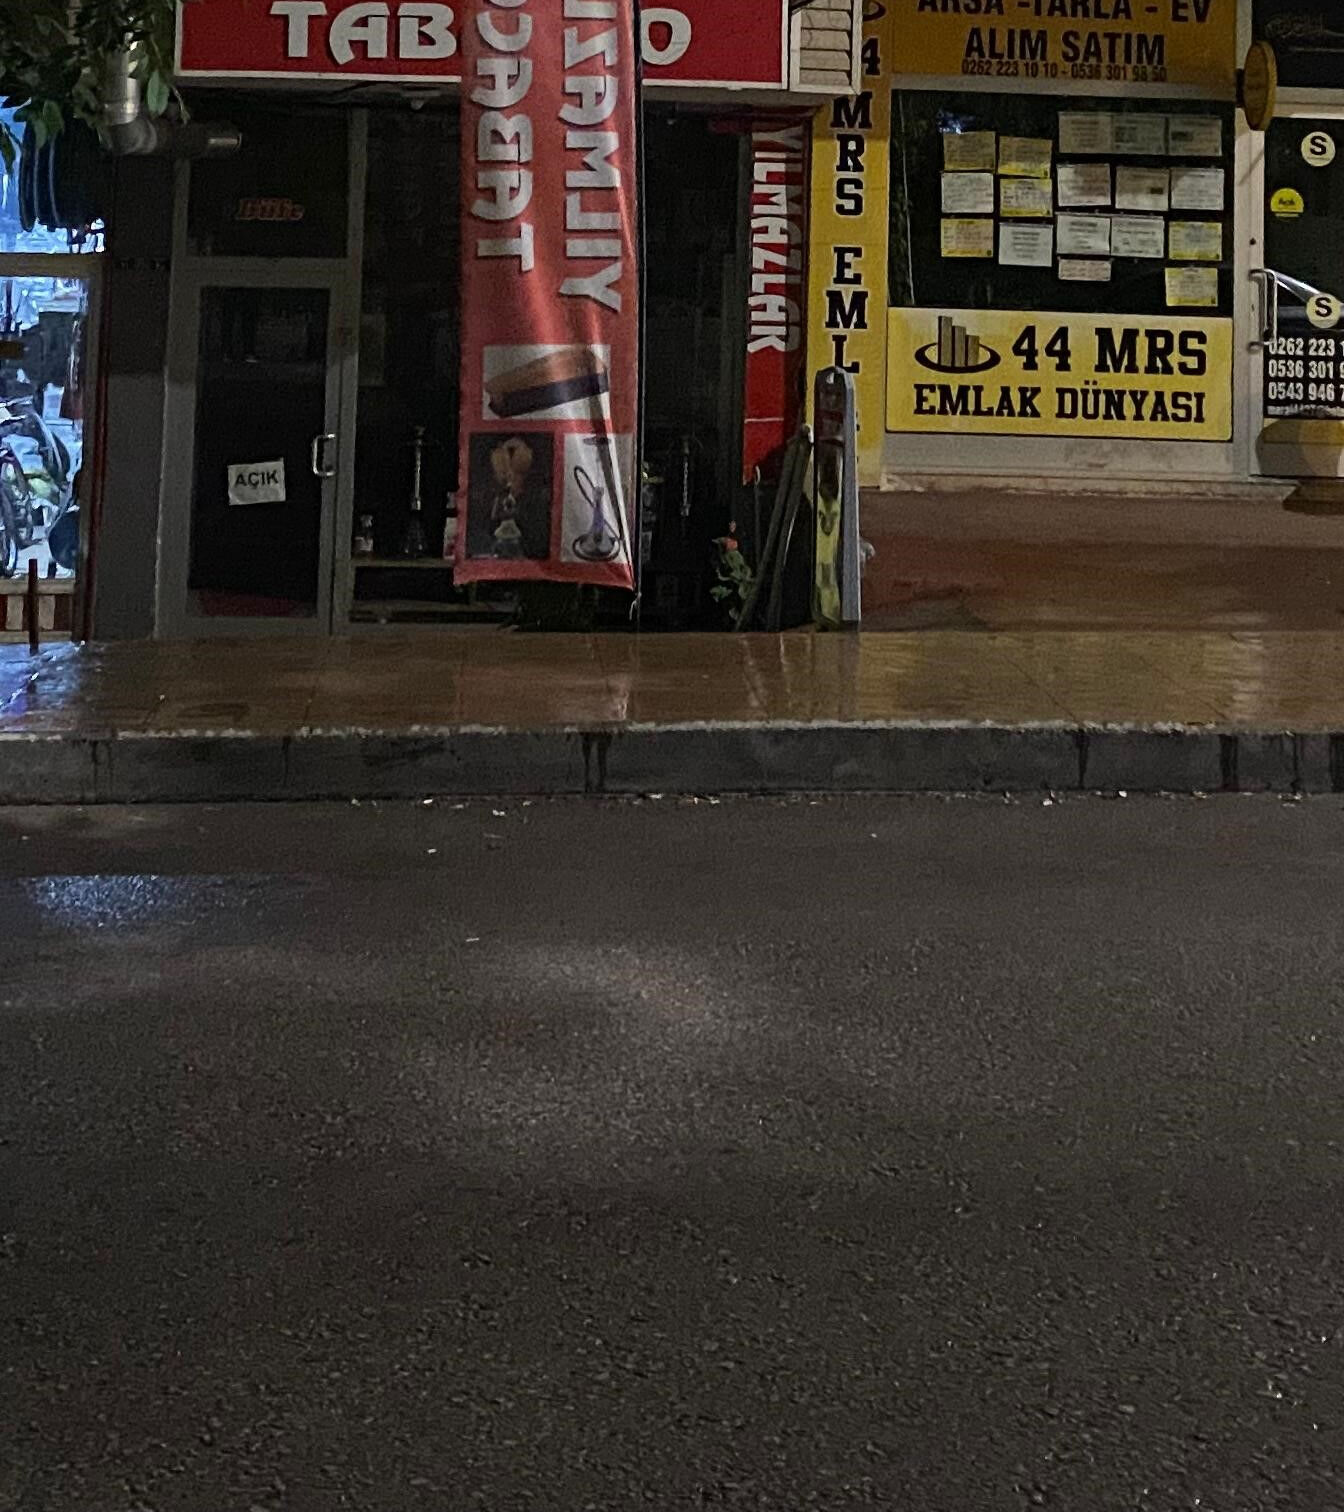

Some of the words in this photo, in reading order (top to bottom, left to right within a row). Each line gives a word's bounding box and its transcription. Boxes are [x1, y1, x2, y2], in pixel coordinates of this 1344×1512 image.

[269, 0, 692, 67] TABO
[965, 27, 1048, 62] ALIM
[1061, 30, 1165, 66] SATIM
[962, 59, 991, 76] 0262
[996, 60, 1020, 77] 223
[1024, 61, 1038, 78] 10
[1043, 62, 1057, 78] 10
[1071, 63, 1101, 80] 0536
[1106, 64, 1127, 80] 301
[1133, 65, 1148, 81] 98
[830, 91, 873, 216] MRS
[747, 121, 804, 354] YILMAZLAR
[1012, 325, 1071, 371] 44
[1094, 327, 1207, 375] MRS
[1268, 337, 1304, 356] 0262
[1308, 338, 1336, 357] 223
[1308, 360, 1334, 379] 301
[913, 384, 1041, 418] EMLAK
[1056, 380, 1205, 423] DÜNYASI
[1268, 381, 1304, 401] 0543
[235, 469, 278, 489] AÇIK
